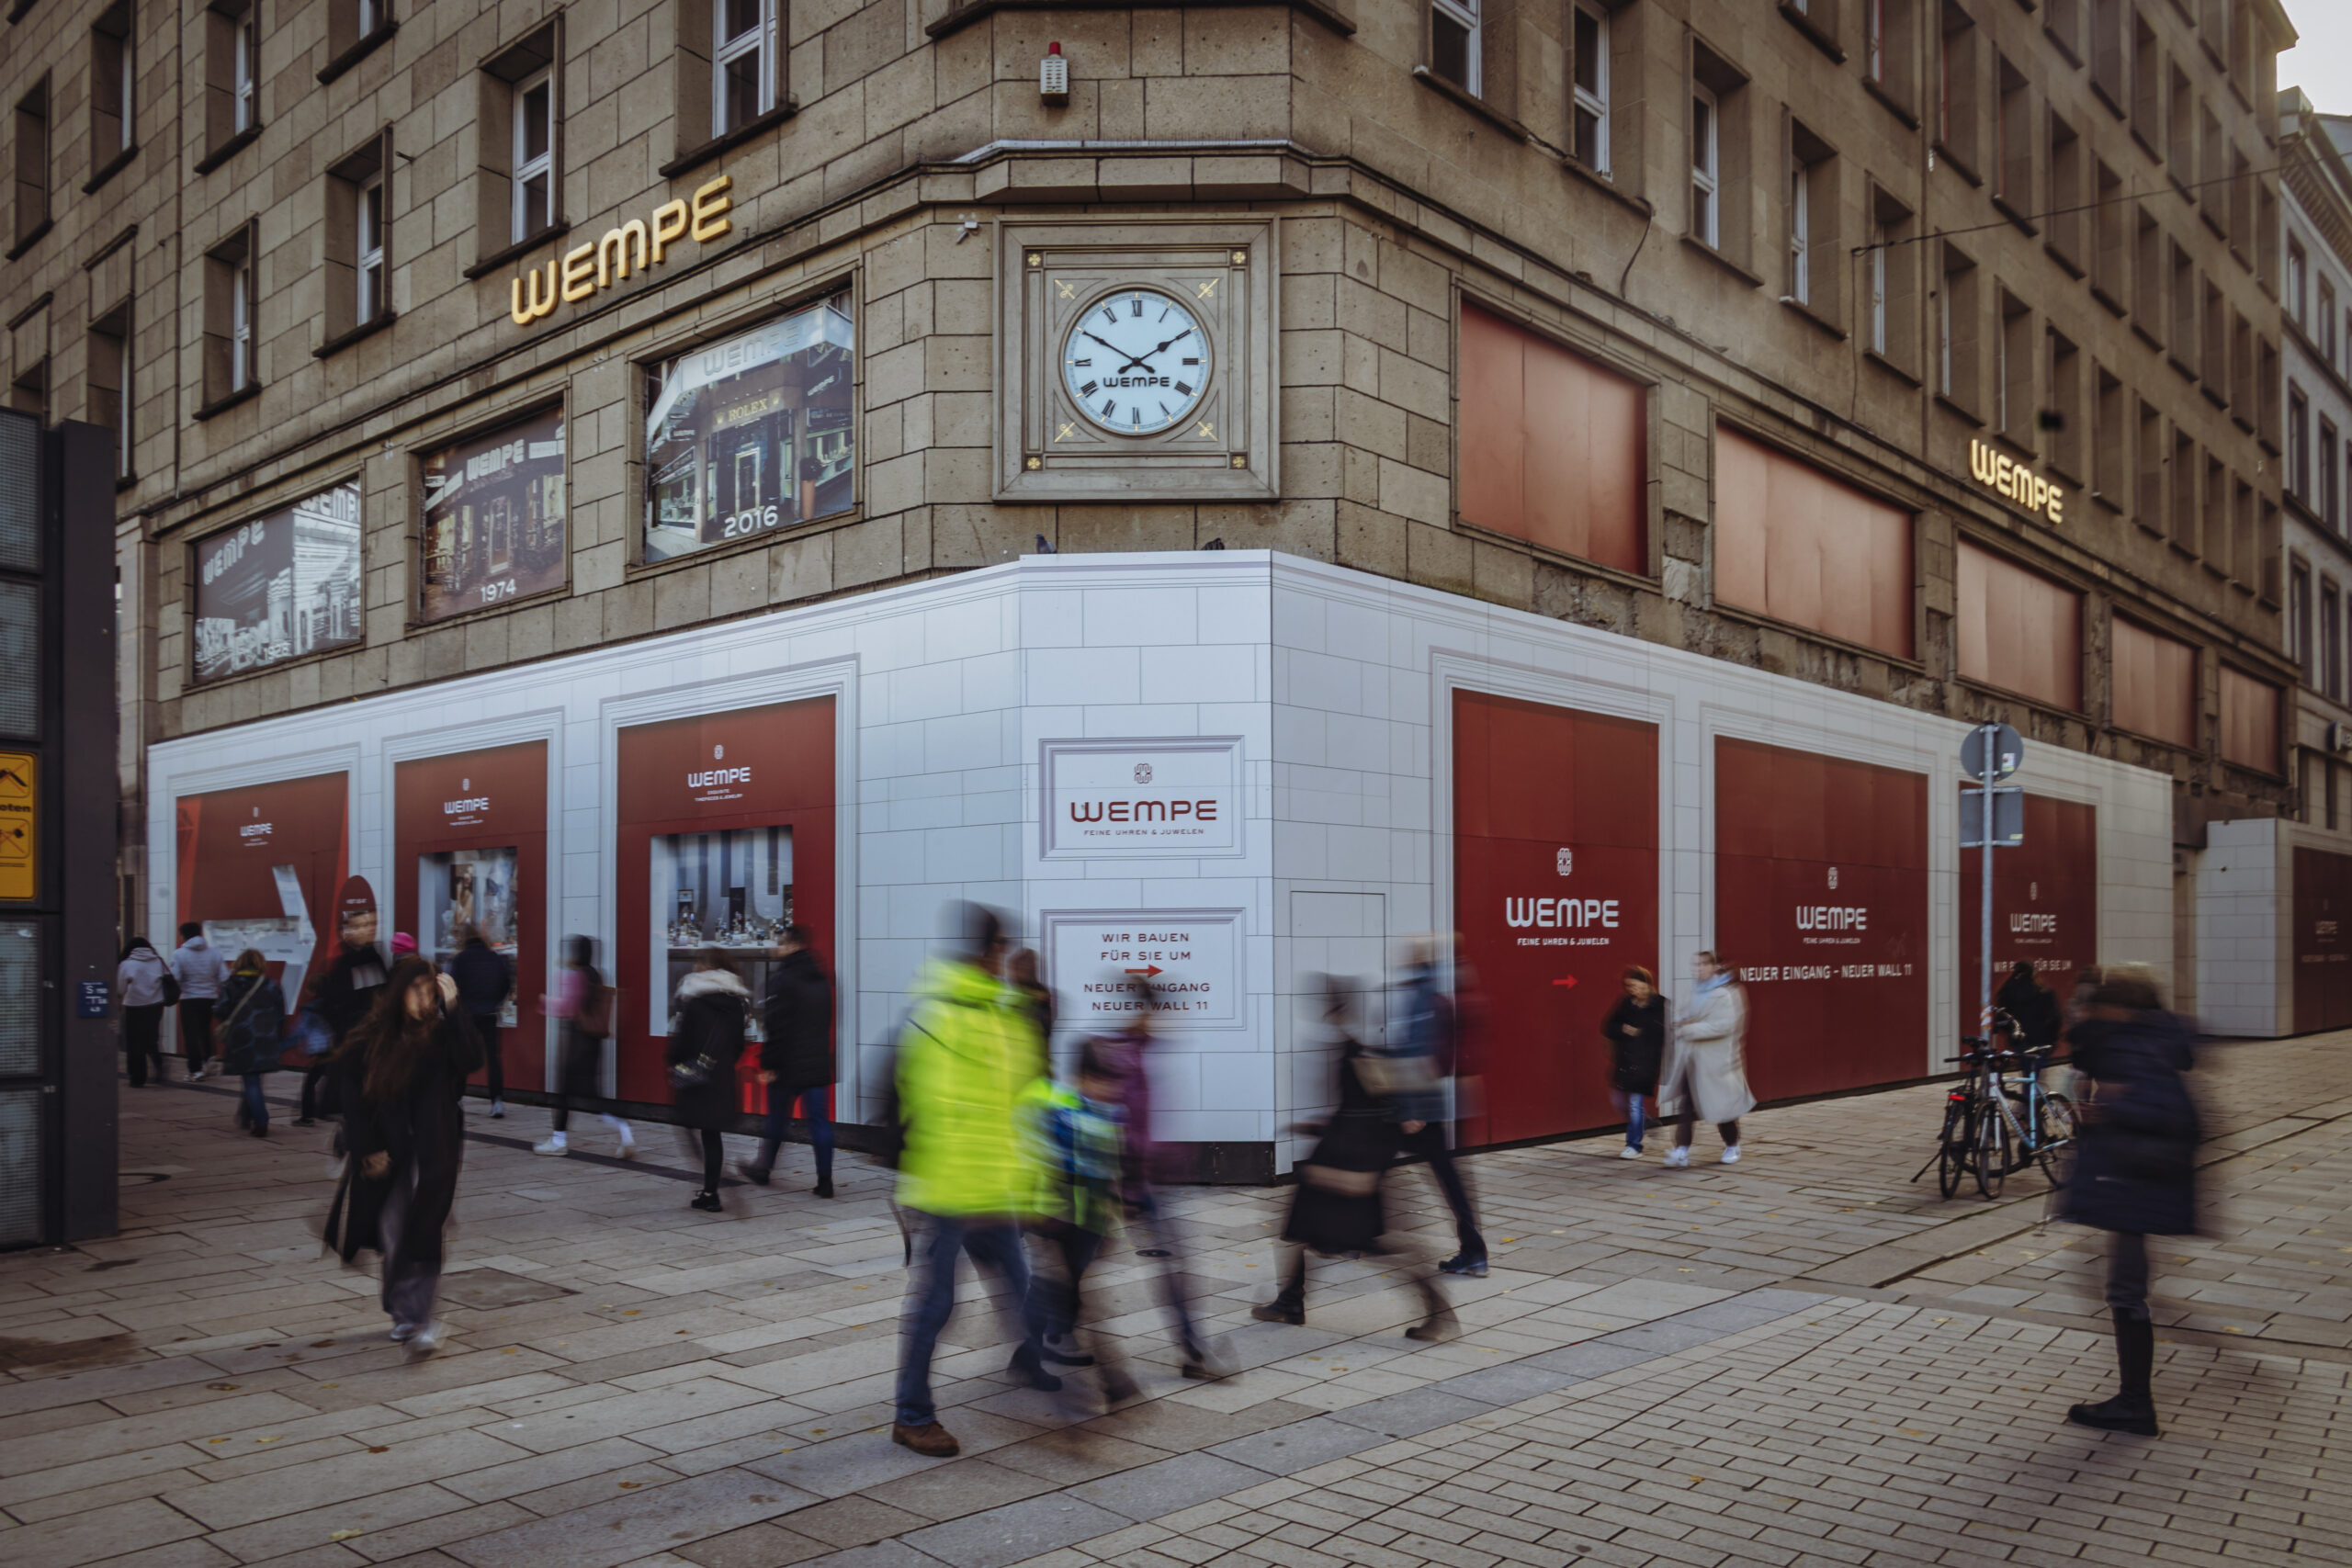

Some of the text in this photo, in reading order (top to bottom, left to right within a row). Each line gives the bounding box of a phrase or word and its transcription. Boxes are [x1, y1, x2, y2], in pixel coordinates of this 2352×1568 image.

[512, 175, 732, 325] WEMPE
[702, 321, 799, 377] WEMPE
[1102, 377, 1170, 388] WEMPE
[728, 398, 769, 423] ROLEX
[466, 437, 525, 481] WEMPE
[1970, 438, 2064, 525] WEMPE
[724, 505, 779, 538] 2016
[203, 519, 266, 586] WEMPE
[481, 578, 516, 603] 1974
[687, 766, 751, 788] WEMPE
[444, 796, 489, 814] WEMPE
[1070, 799, 1217, 822] WEMPE
[1506, 897, 1620, 928] WEMPE
[1796, 905, 1868, 931] WEMPE
[2010, 913, 2057, 932] WEMPE
[1102, 933, 1190, 942] WIR BAUEN
[1517, 938, 1541, 946] FEINE
[1101, 950, 1191, 961] FÜR SIE UM
[1740, 966, 1779, 982] NEUER
[1782, 965, 1831, 981] EINGANG
[1841, 965, 1875, 978] NEUER
[1878, 964, 1903, 977] WALL
[1904, 964, 1913, 976] 11
[1084, 983, 1210, 993] NEUER INGANG
[1091, 1001, 1208, 1011] NEUER WALL 11
